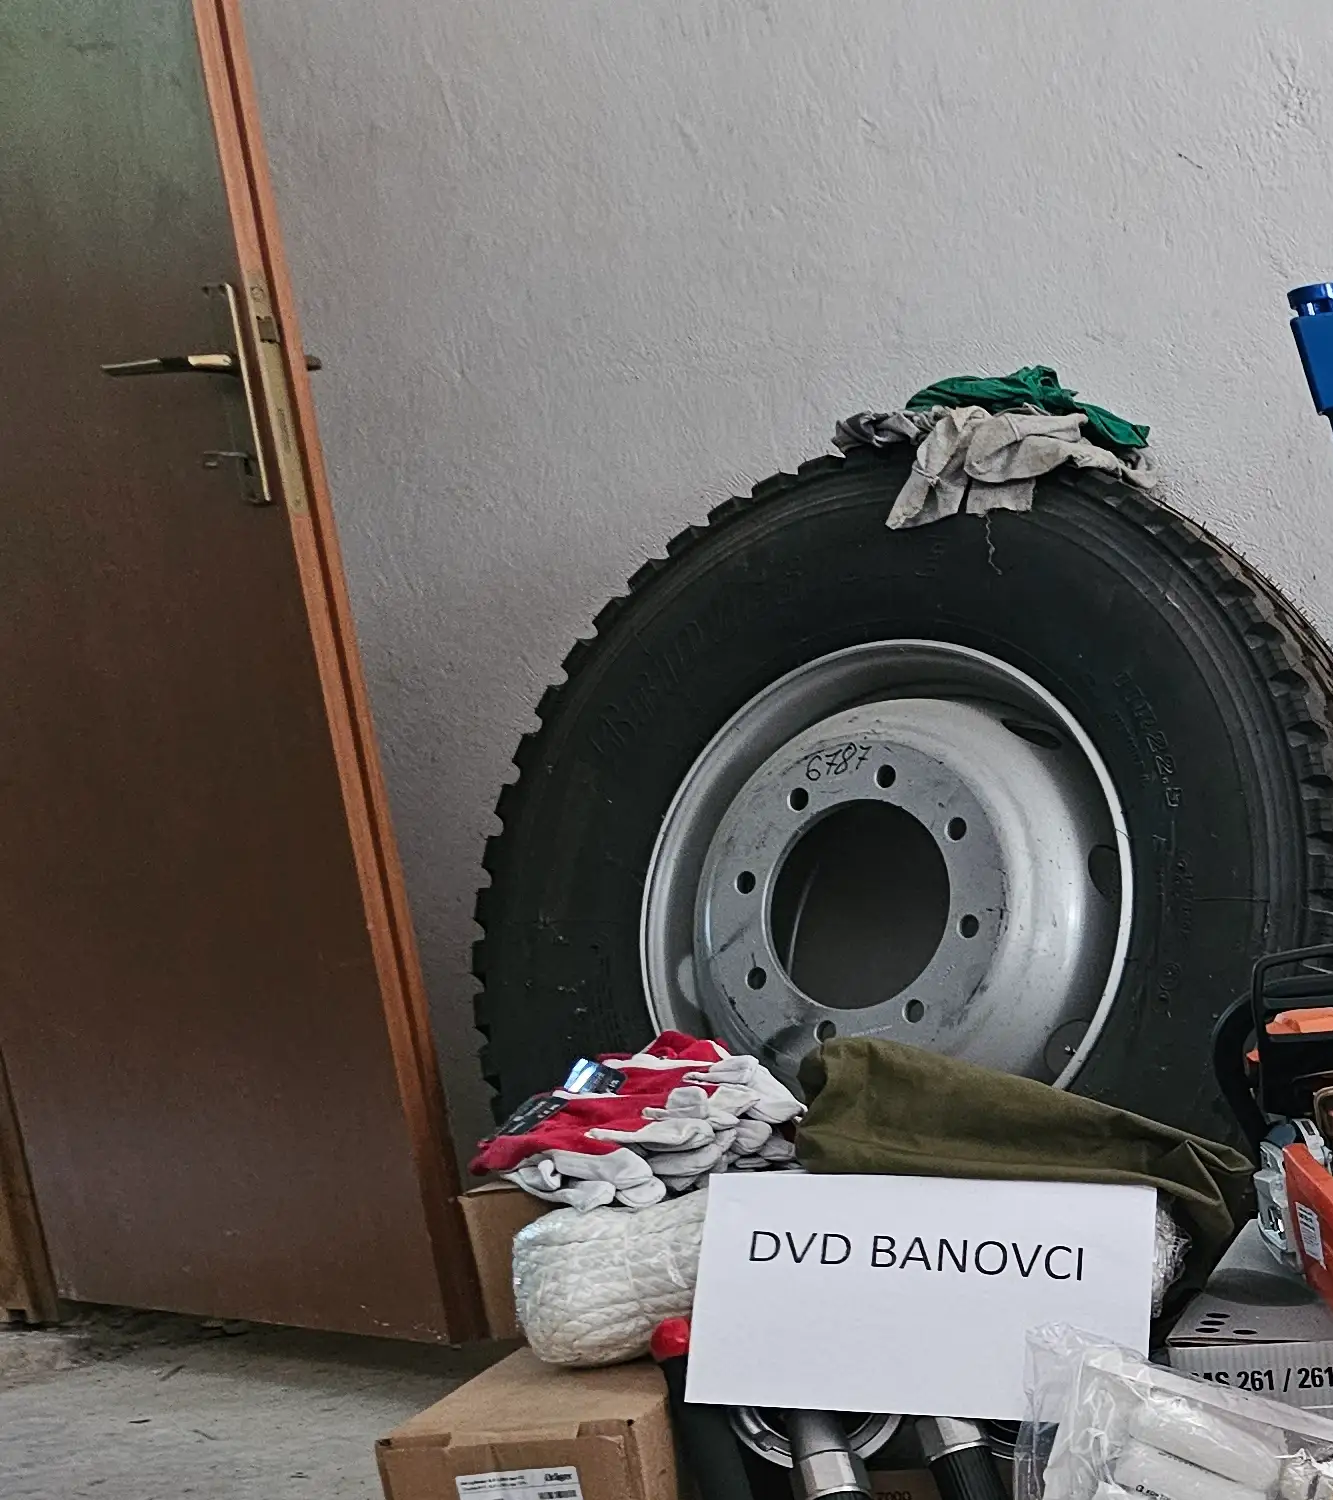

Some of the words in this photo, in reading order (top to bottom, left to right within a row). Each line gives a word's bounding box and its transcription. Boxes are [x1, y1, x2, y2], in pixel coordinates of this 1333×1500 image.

[806, 742, 872, 781] 6787
[749, 1231, 851, 1265] DVD
[870, 1235, 1084, 1281] BANOVCI
[1237, 1370, 1275, 1391] 261
[1284, 1368, 1292, 1392] /
